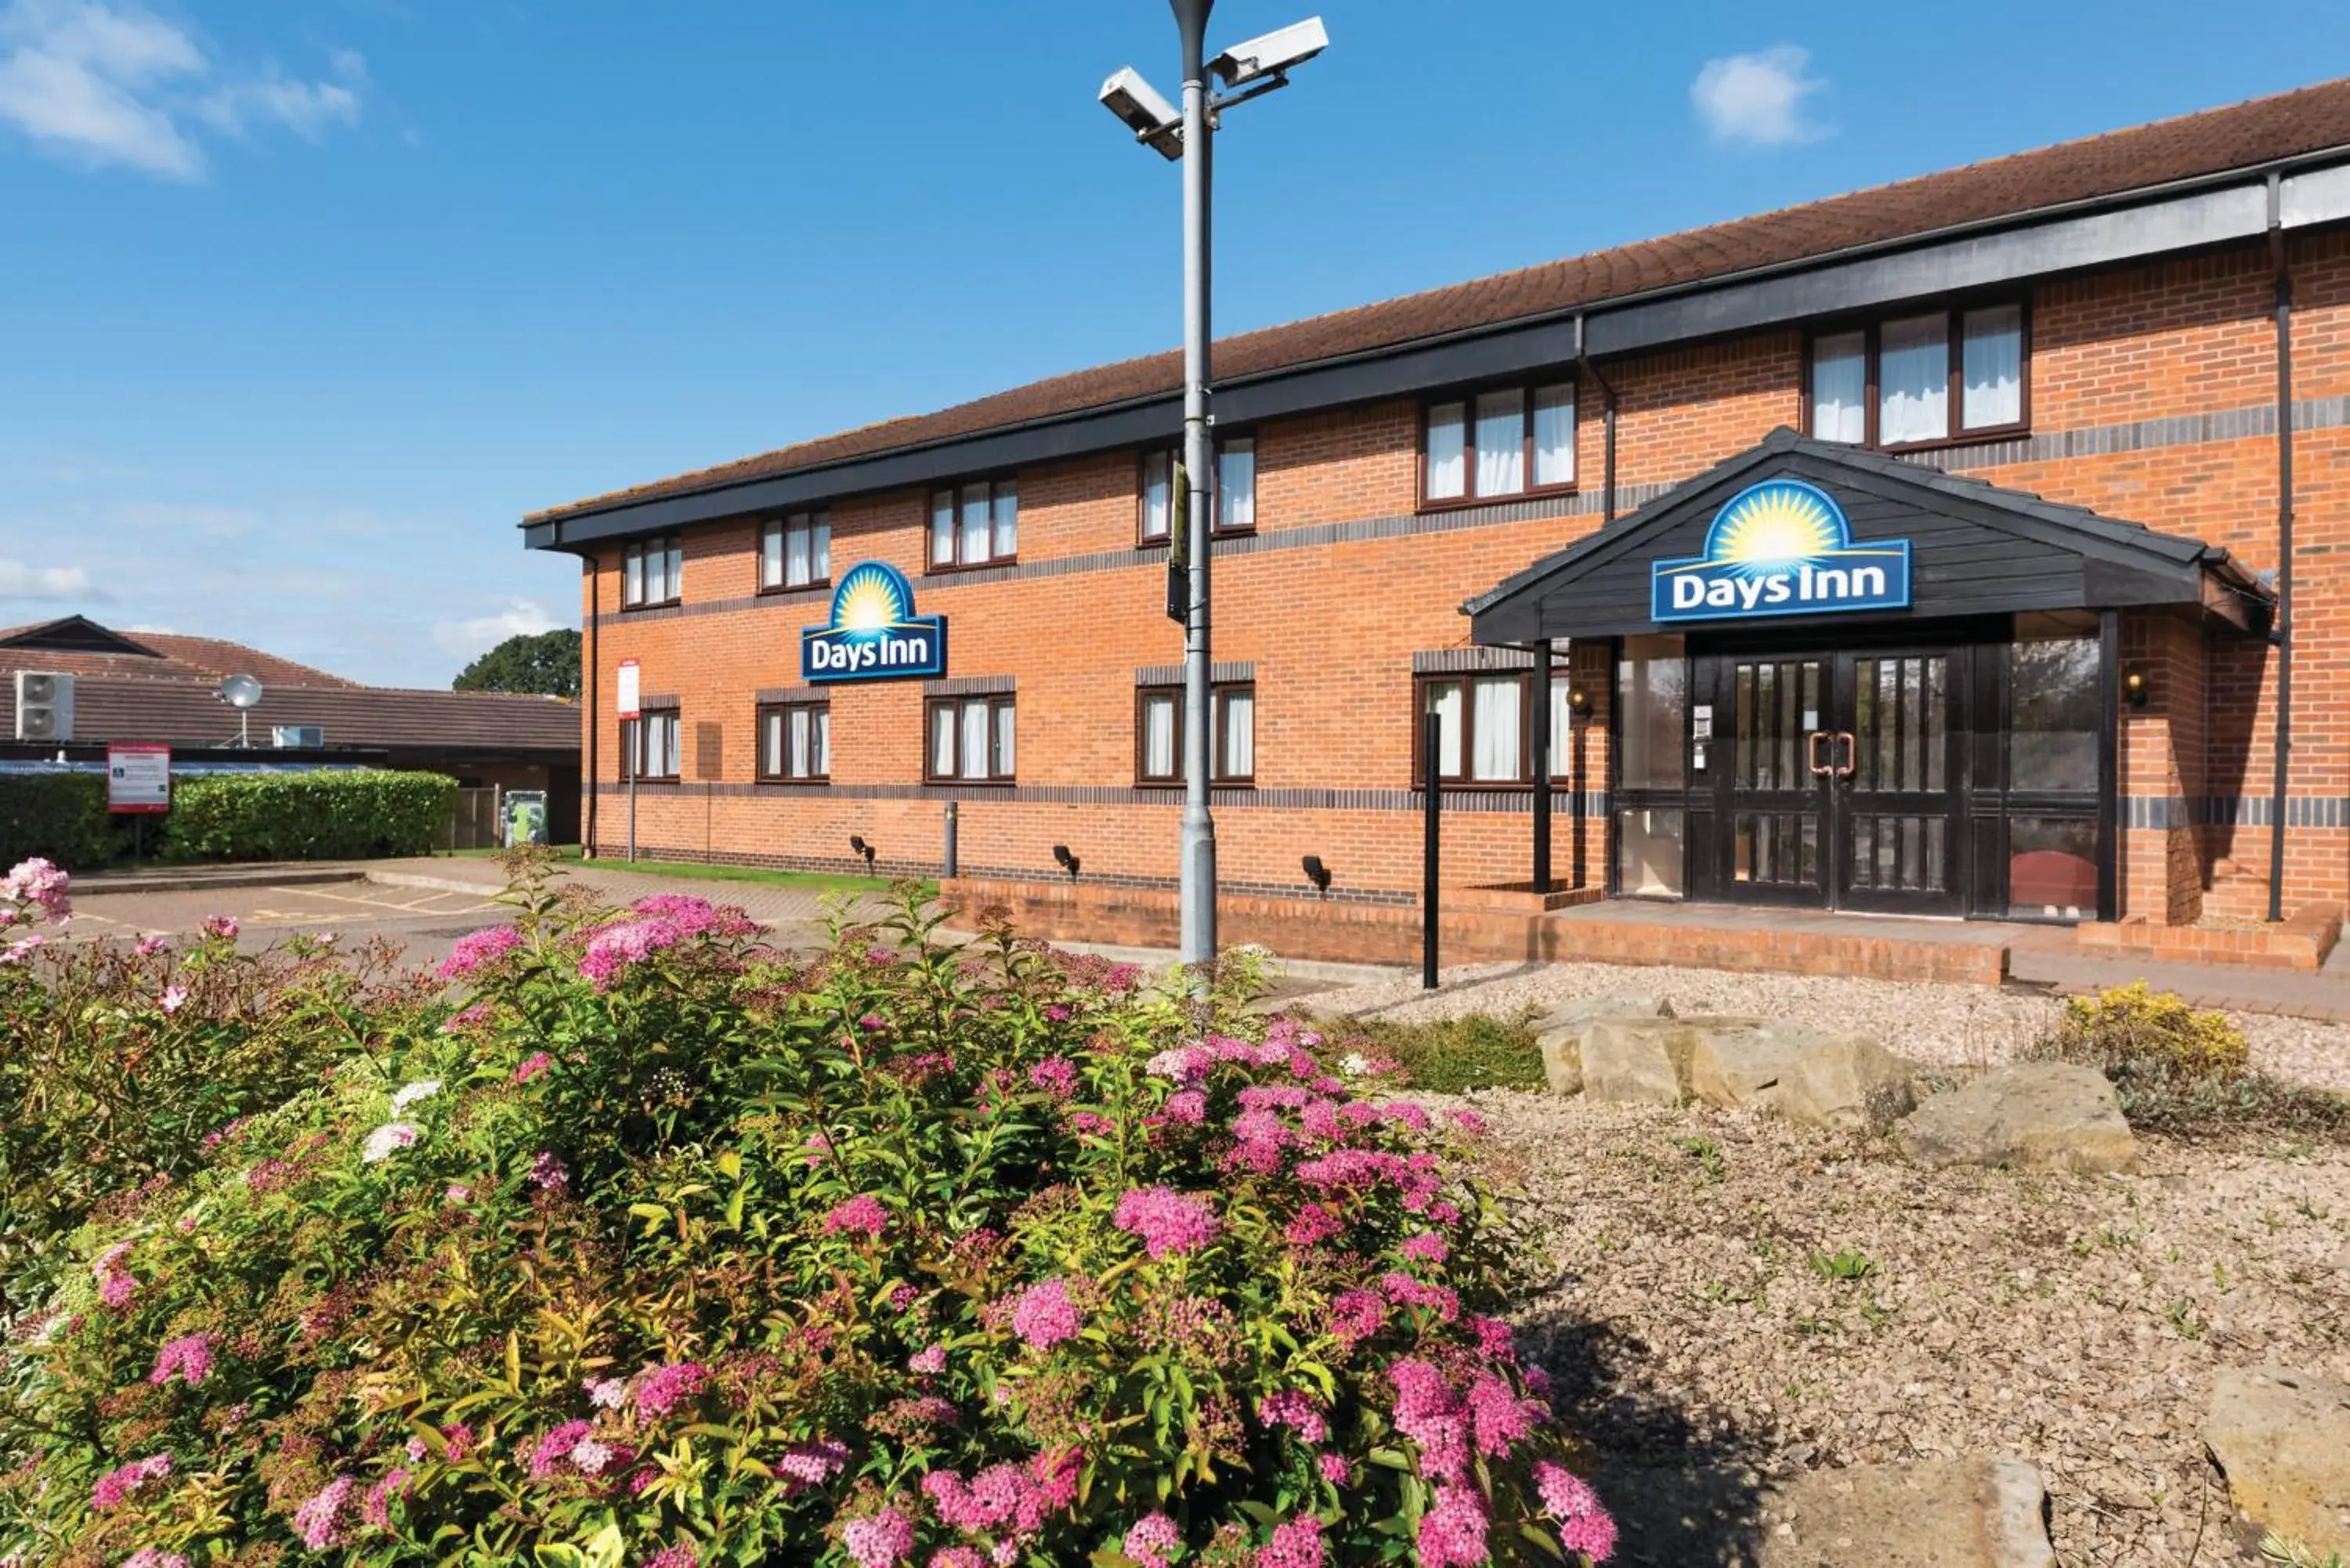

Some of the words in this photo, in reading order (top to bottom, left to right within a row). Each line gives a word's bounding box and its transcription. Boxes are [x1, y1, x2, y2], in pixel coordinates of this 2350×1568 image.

[1672, 574, 1791, 609] Days
[1799, 566, 1885, 601] Inn
[812, 640, 877, 671] Days
[880, 634, 927, 665] Inn
